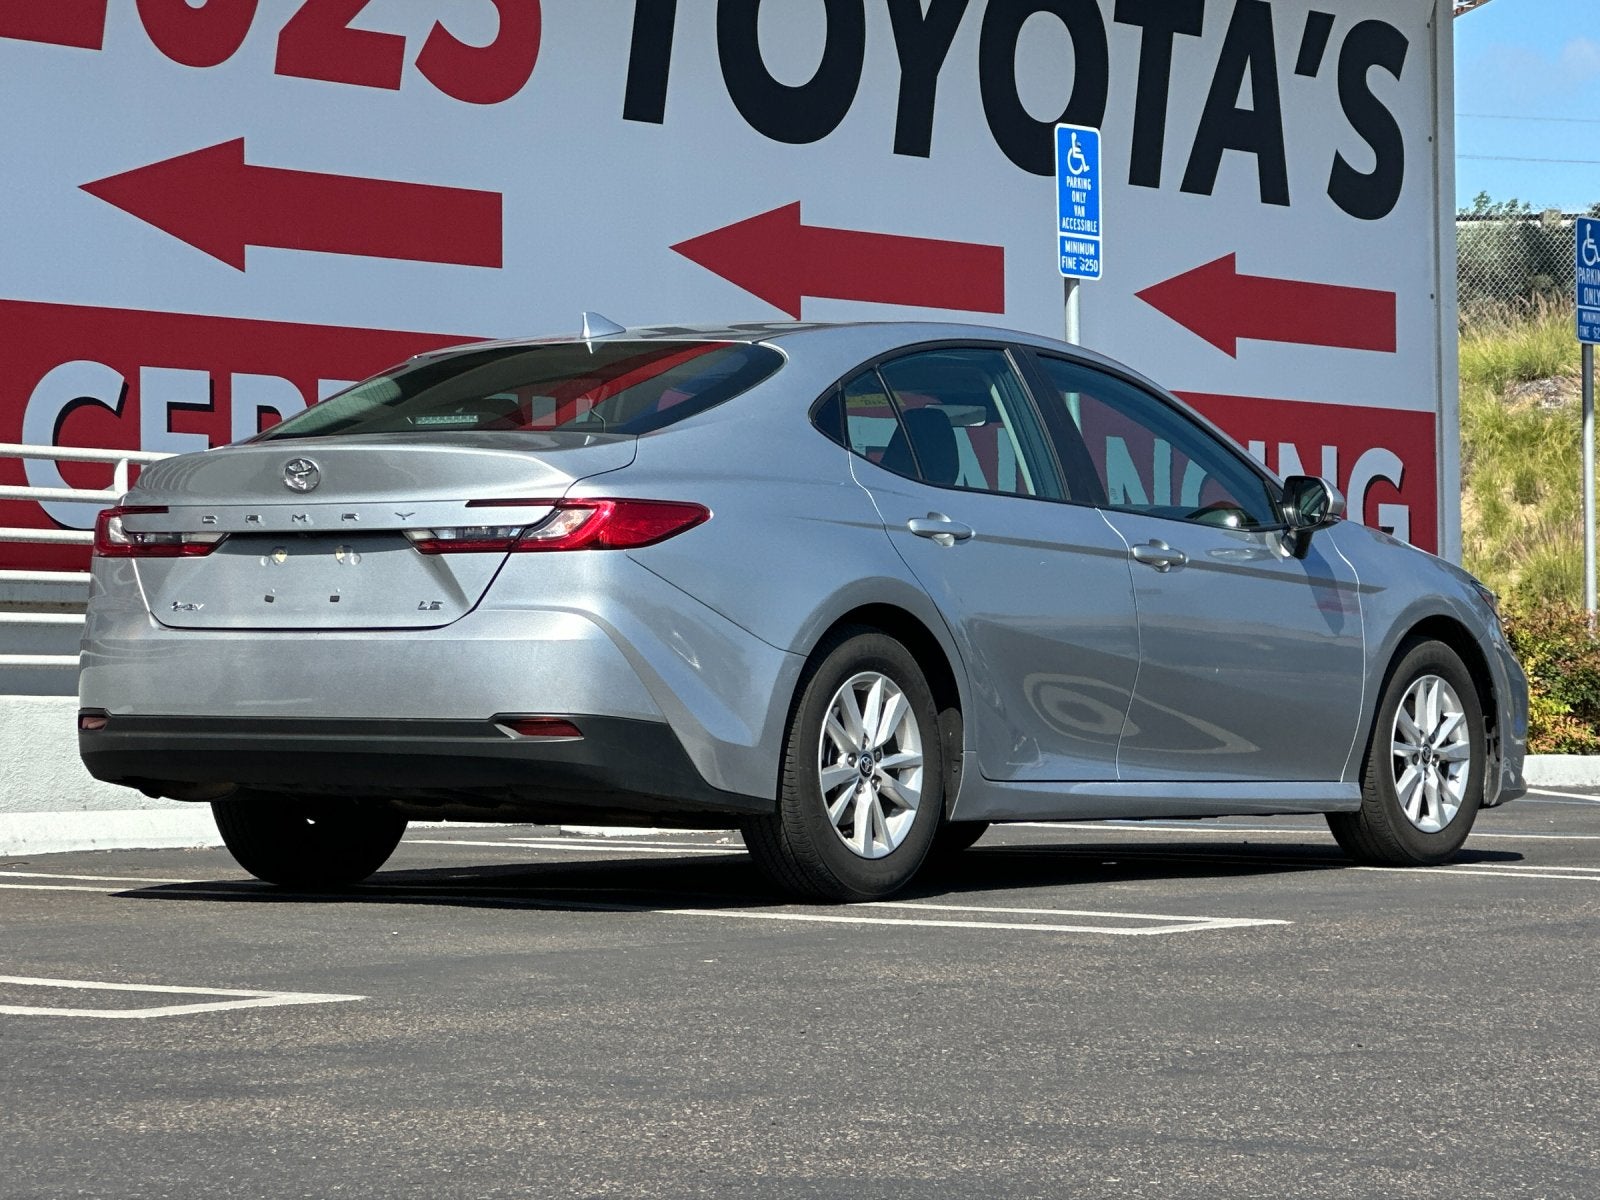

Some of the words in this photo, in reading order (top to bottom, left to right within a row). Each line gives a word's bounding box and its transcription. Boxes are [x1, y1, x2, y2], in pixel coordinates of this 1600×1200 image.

[1066, 176, 1092, 190] PARKING
[1071, 191, 1087, 204] ONLY
[1074, 205, 1085, 217] VAN
[1062, 217, 1097, 233] ACCESSIBLE
[1064, 240, 1095, 256] MINIMUM
[1061, 256, 1077, 270] FINE
[202, 511, 416, 525] CAMRY
[417, 600, 445, 611] LE
